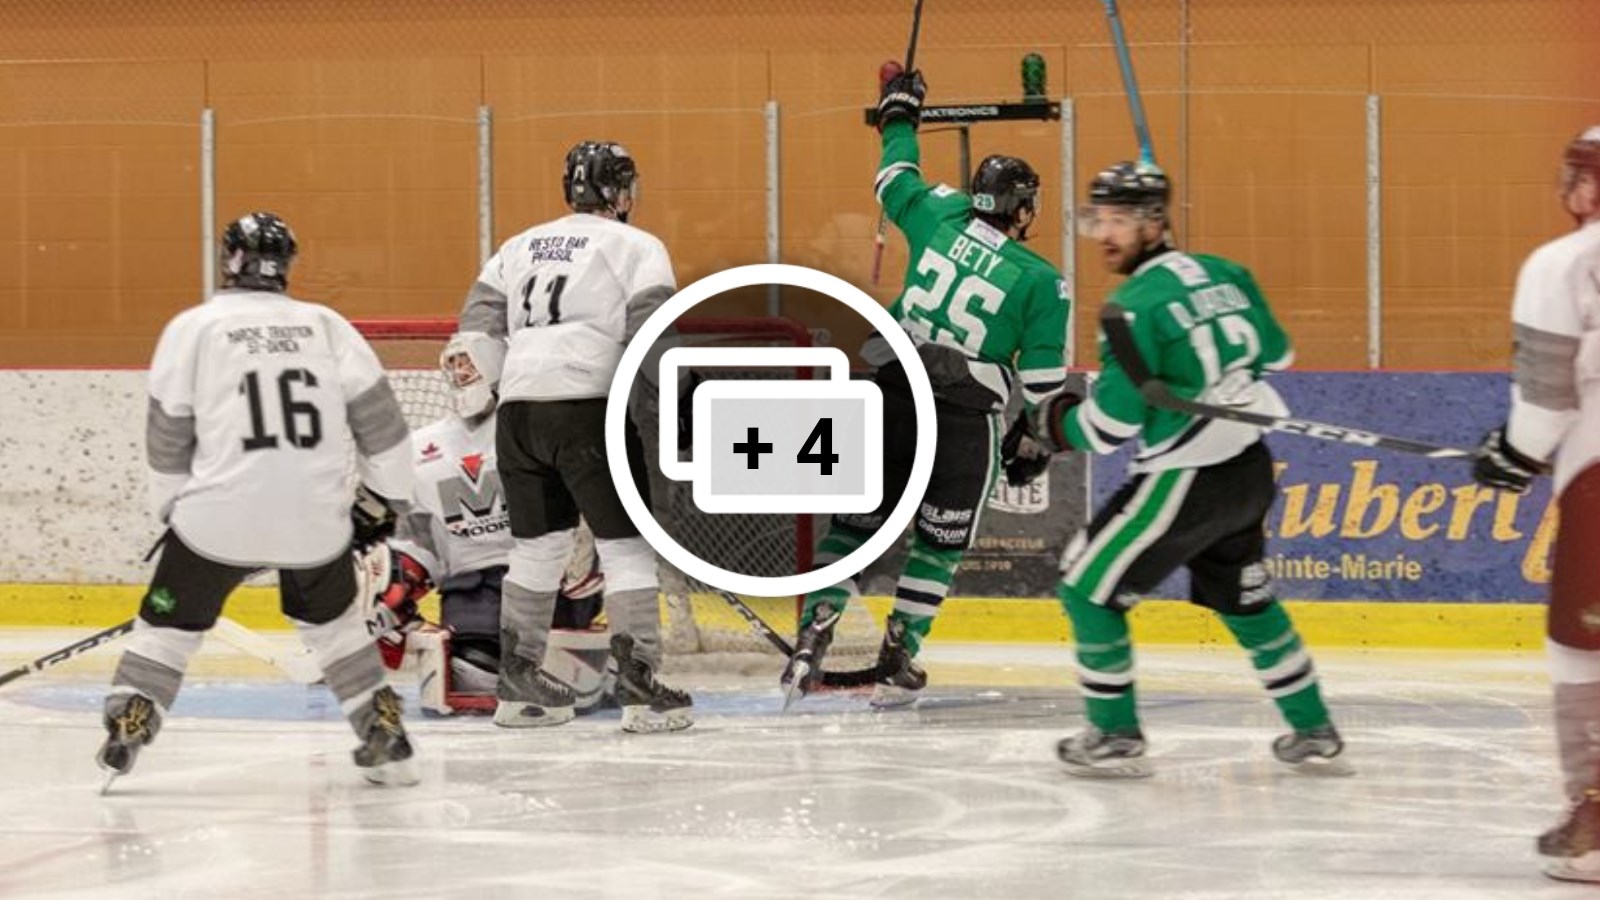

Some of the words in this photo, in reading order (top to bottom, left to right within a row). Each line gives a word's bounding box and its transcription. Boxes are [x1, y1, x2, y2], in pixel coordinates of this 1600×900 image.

[920, 106, 998, 119] AKTRONICS
[948, 235, 1003, 278] BETY
[521, 275, 569, 327] 11
[902, 247, 1007, 358] 25
[239, 367, 323, 453] 16
[1272, 459, 1523, 542] ubert
[1264, 554, 1423, 581] ainte-Marie
